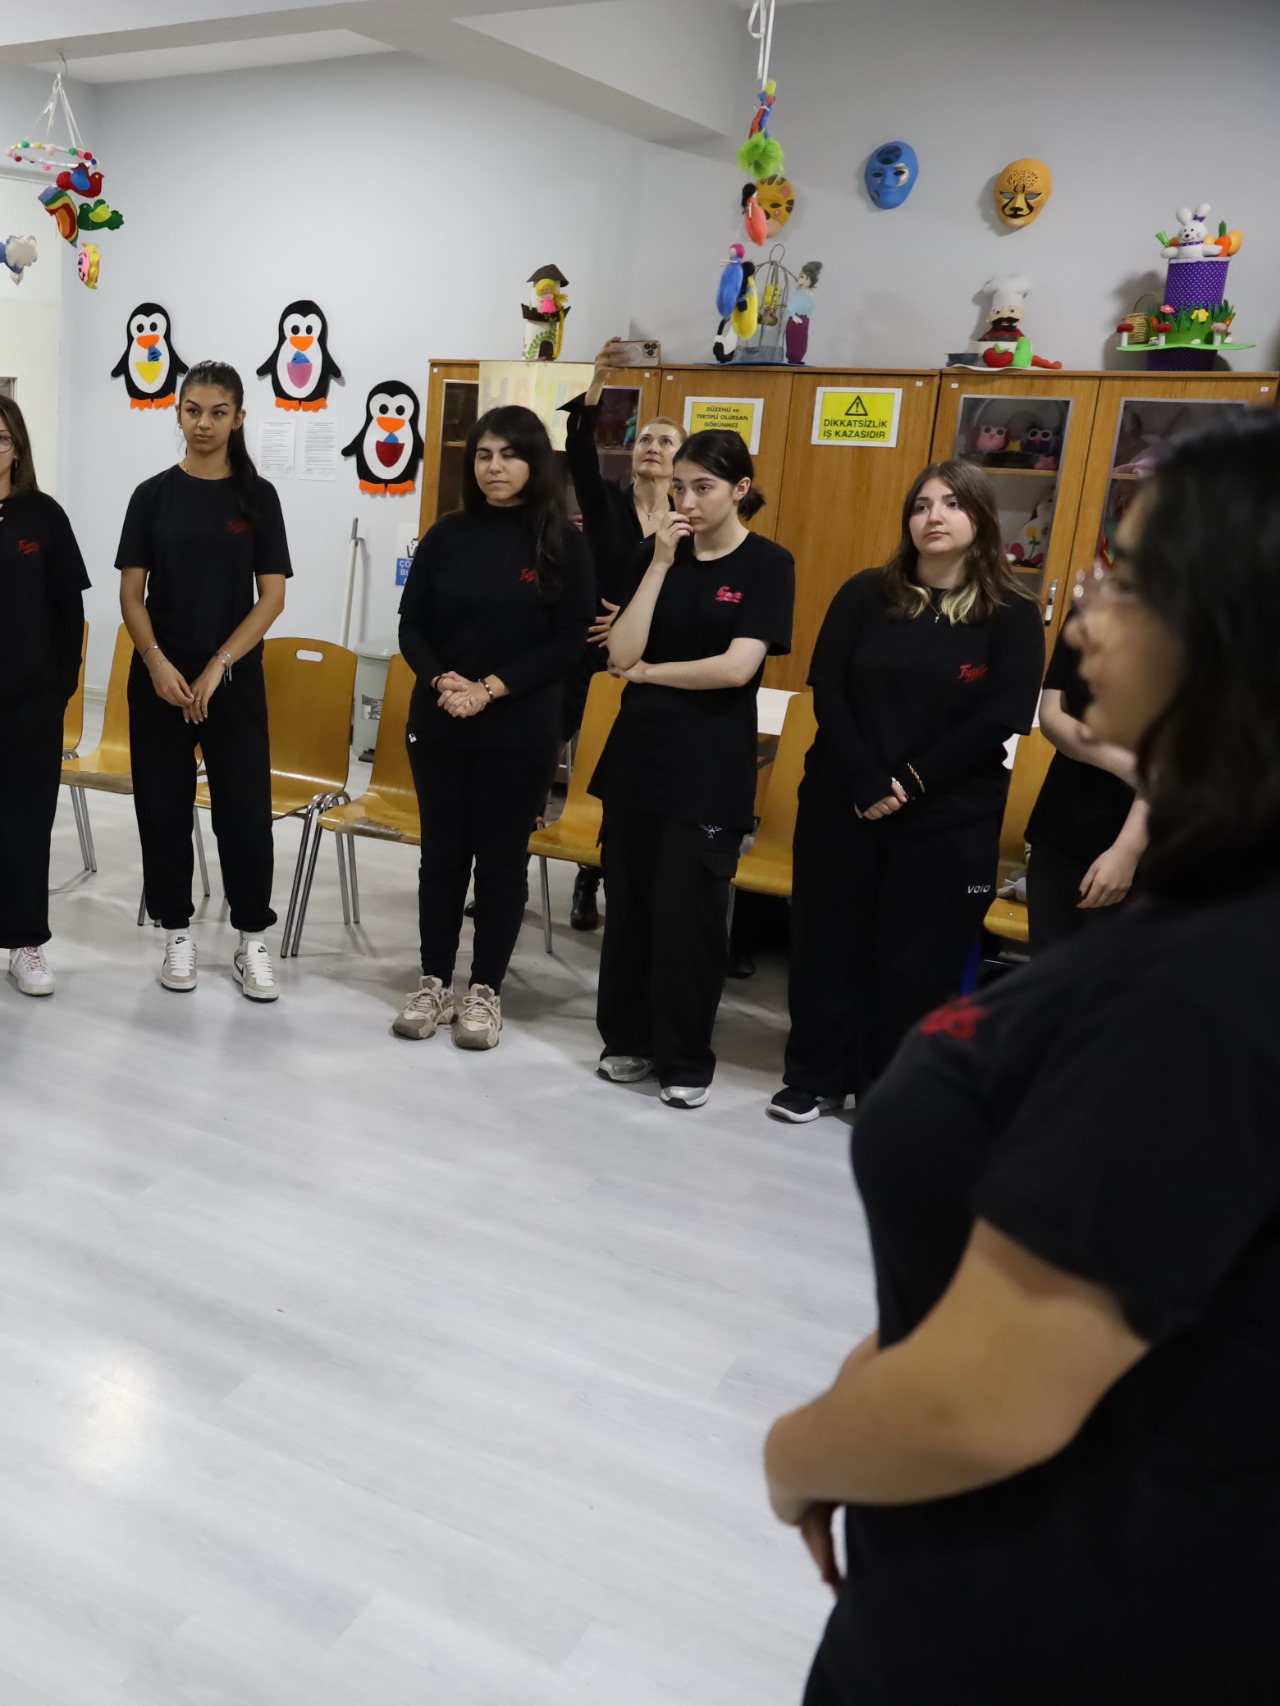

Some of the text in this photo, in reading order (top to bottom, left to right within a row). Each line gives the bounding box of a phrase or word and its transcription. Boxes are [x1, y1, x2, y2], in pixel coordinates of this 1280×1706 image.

[706, 405, 731, 413] DÜZENLİ
[704, 420, 739, 428] GÖRÜNMEZ
[823, 418, 888, 428] DİKKATSİZLİK
[823, 428, 886, 439] İŞ KAZASIDIR
